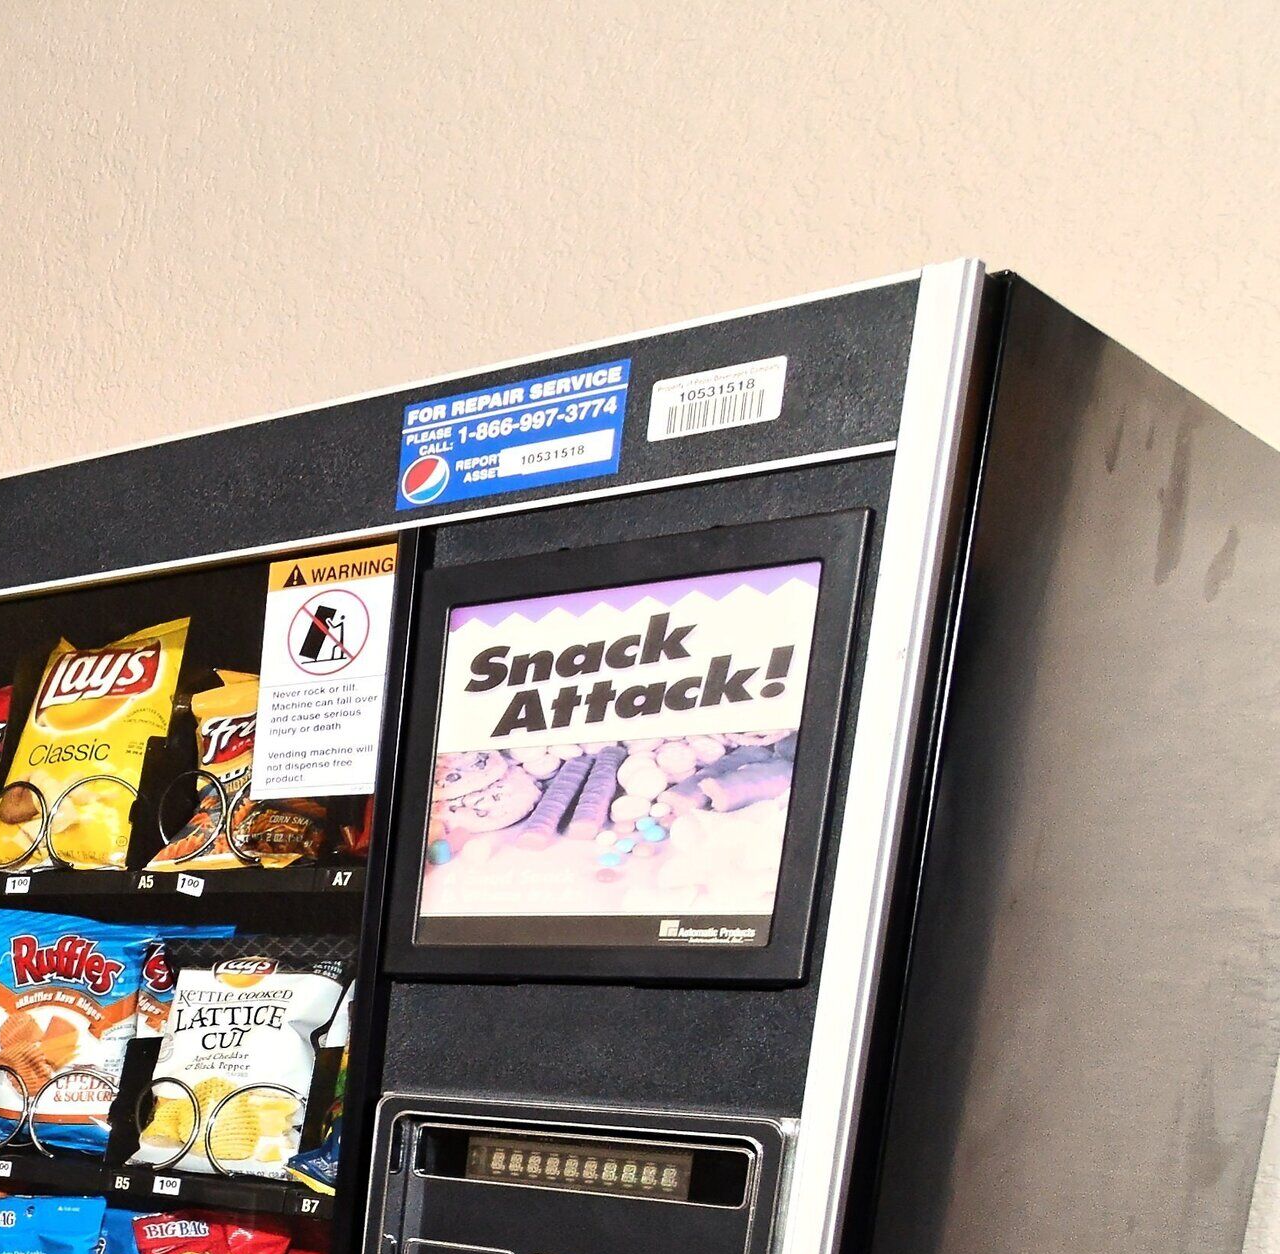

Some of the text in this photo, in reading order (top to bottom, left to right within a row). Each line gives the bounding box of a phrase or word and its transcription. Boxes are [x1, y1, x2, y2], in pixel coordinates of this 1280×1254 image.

[407, 365, 622, 426] FOR REPAIR SERVICE
[680, 378, 755, 402] 10531518
[406, 395, 618, 446] PLEASE 1-866-997-3774
[418, 442, 454, 457] CALL:
[520, 445, 585, 465] 10531518
[311, 556, 395, 584] WARNING
[464, 612, 698, 693] Snack
[273, 686, 340, 700] Never rock or
[490, 644, 796, 738] Attack!
[271, 694, 379, 712] Machine can fall over
[270, 708, 362, 724] and cause serious
[269, 725, 311, 737] injury or
[28, 738, 111, 766] Classic
[268, 744, 374, 762] Vending machine will
[267, 758, 353, 773] not dispense free
[138, 875, 154, 889] A5
[332, 871, 352, 887] A7
[13, 935, 125, 995] Ruffles
[174, 1005, 286, 1033] LATTICE
[201, 1028, 251, 1051] CUT
[114, 1177, 130, 1190] B5
[301, 1199, 319, 1213] B7
[146, 1222, 209, 1239] BIG BAG
